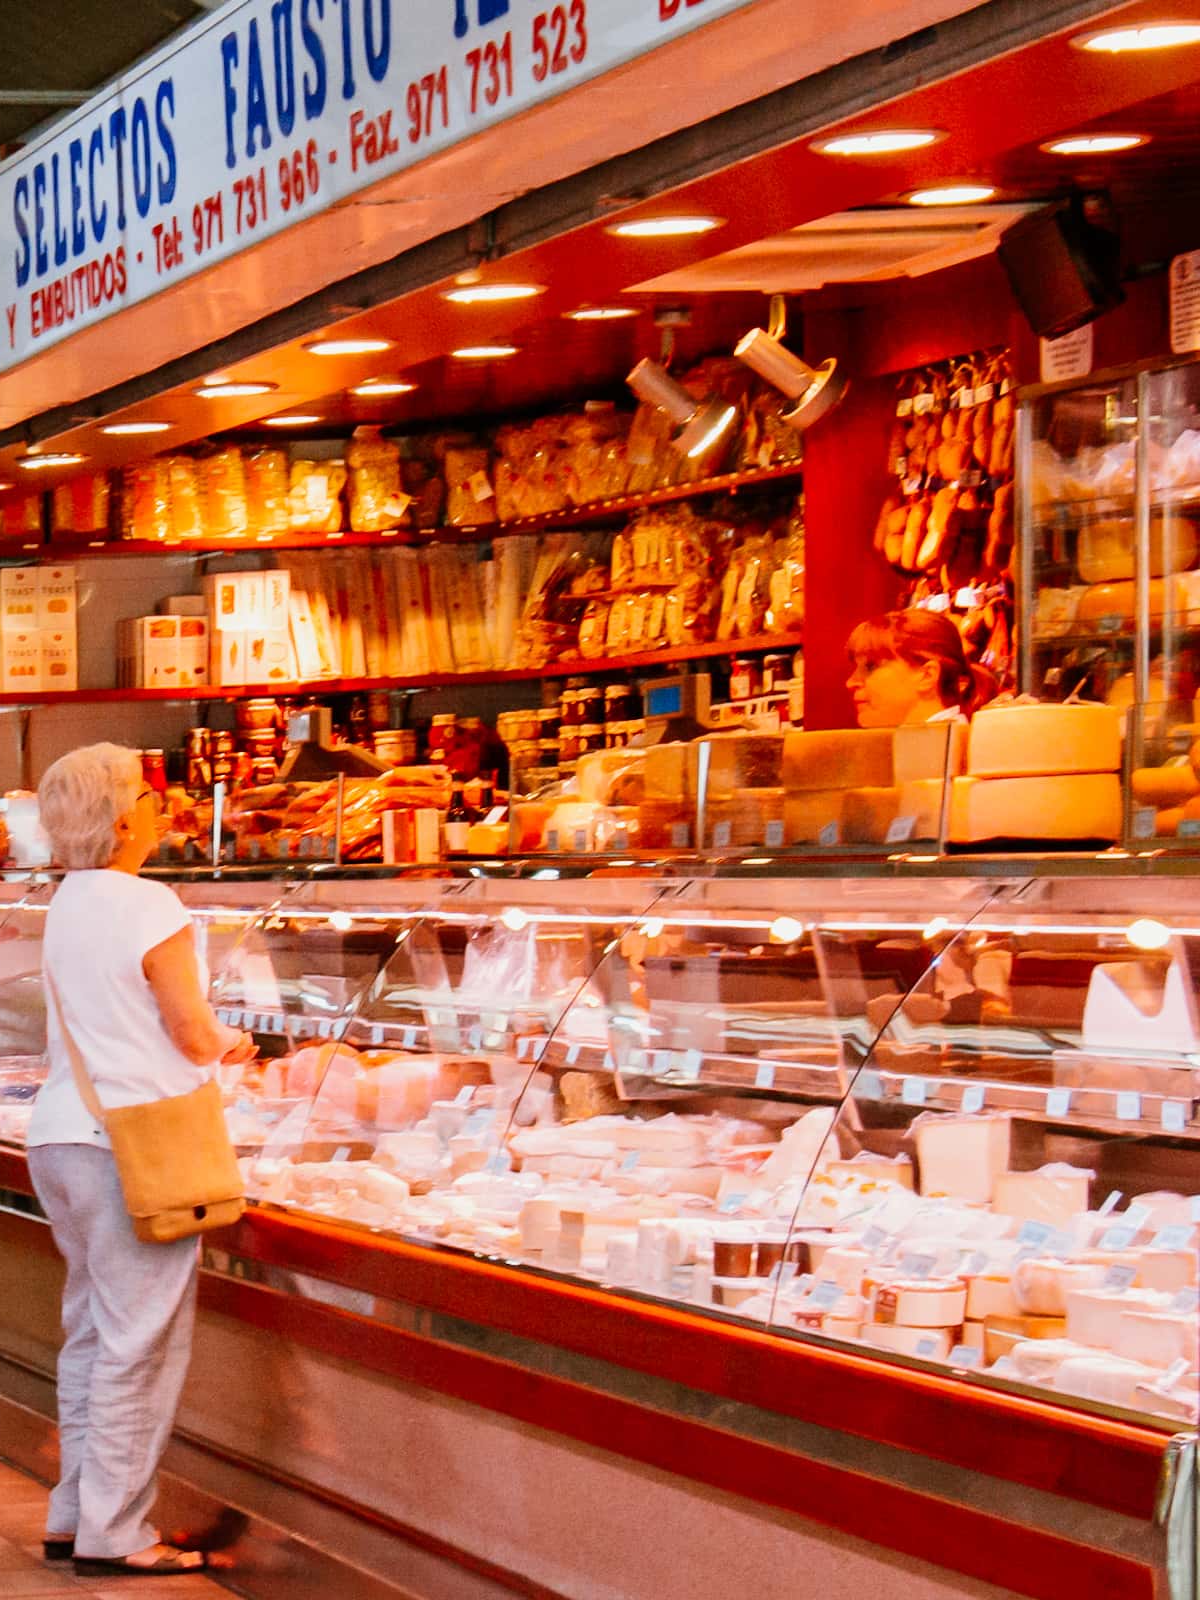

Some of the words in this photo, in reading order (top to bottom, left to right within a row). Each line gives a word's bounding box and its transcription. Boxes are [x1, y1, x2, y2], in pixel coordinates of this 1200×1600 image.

[6, 304, 16, 349] Y
[31, 246, 127, 337] EMBUTIDOS
[193, 190, 223, 255] 971
[233, 167, 267, 234] 731
[279, 138, 319, 211] 966
[406, 65, 448, 144] 971
[466, 31, 513, 114] 731
[532, 0, 587, 82] 523
[13, 77, 177, 287] SELECTOS
[221, 0, 392, 169] FAUSTO
